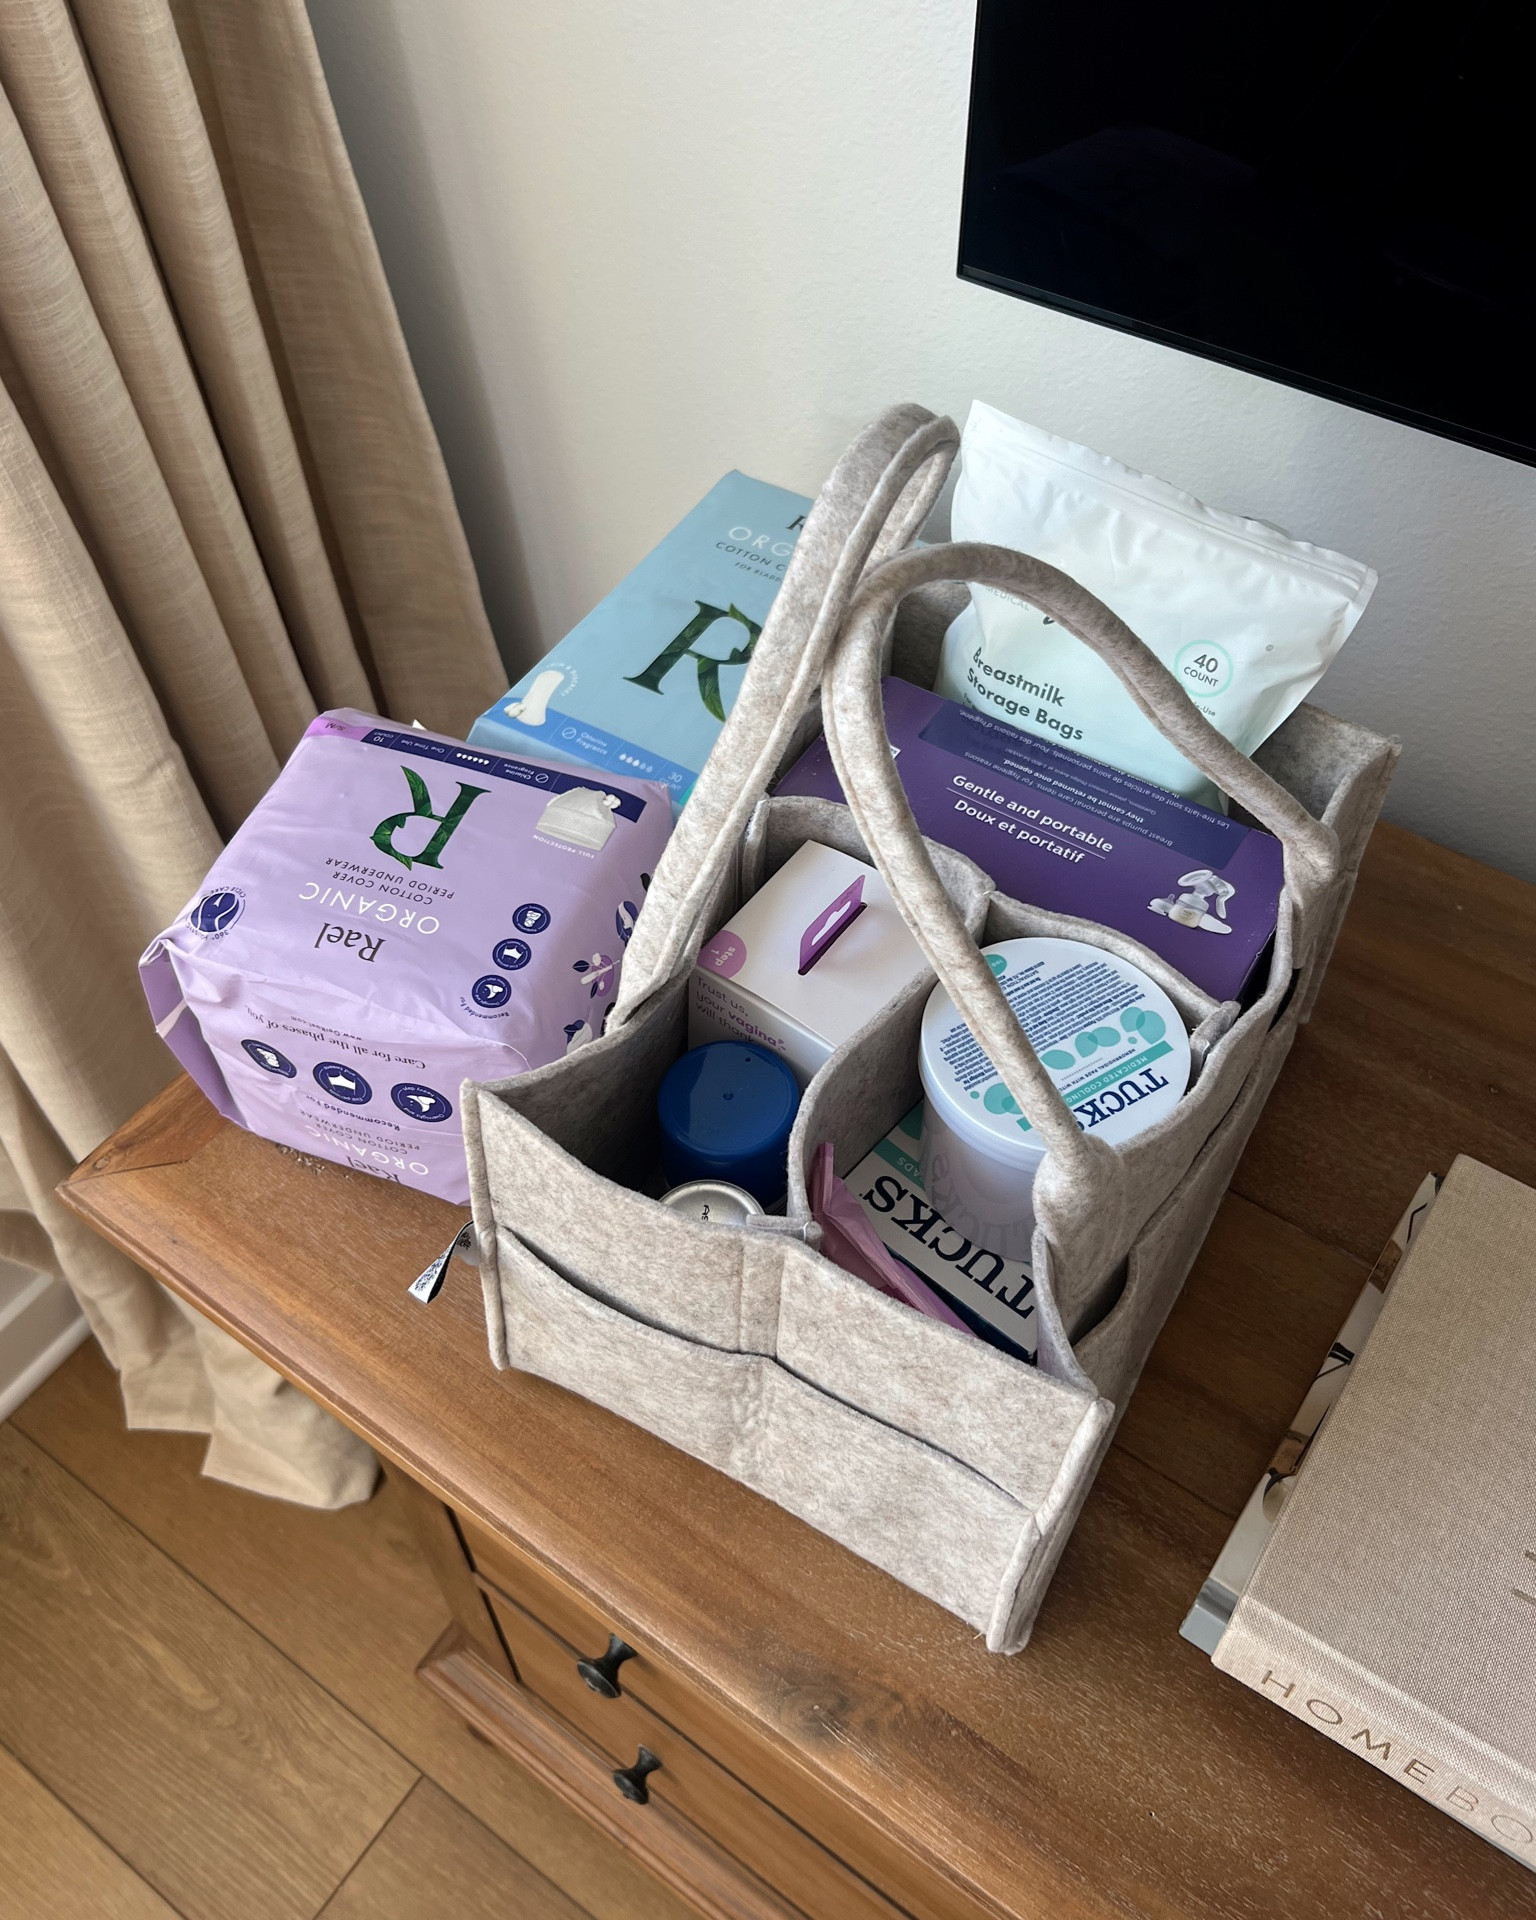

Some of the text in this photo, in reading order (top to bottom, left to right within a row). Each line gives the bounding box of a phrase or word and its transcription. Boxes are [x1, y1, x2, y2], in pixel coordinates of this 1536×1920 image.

[728, 527, 792, 557] ORG
[716, 541, 772, 567] COTTON
[1193, 654, 1219, 673] 40
[973, 646, 1066, 707] Breastmilk
[1183, 666, 1219, 687] COUNT
[967, 667, 1030, 719] Storage
[1036, 712, 1084, 743] Bags
[413, 742, 428, 750] Time
[432, 745, 446, 754] One
[1018, 735, 1032, 745] des
[1031, 742, 1049, 753] Pour
[963, 751, 992, 767] reasons
[505, 769, 532, 780] Chlorine
[668, 771, 683, 783] 30
[991, 763, 1020, 780] hygiene
[1020, 776, 1033, 786] For
[1091, 767, 1111, 779] soins
[1111, 775, 1122, 784] de
[1001, 757, 1144, 823] they cannot be returned once opened.
[1057, 792, 1074, 802] care
[1122, 780, 1150, 796] articles
[1150, 792, 1165, 802] des
[1073, 798, 1107, 818] personal
[1165, 798, 1182, 809] sont
[369, 764, 492, 871] R
[952, 774, 1114, 853] Gentle and portable
[1107, 813, 1121, 823] are
[954, 799, 1085, 864] Doux et portatif
[1121, 819, 1148, 835] pumps
[532, 834, 576, 853] PROTECTION
[1147, 831, 1173, 847] Breast
[325, 857, 456, 900] PERIOD UNDERWEAR
[332, 871, 433, 906] COTTON COVER
[300, 881, 440, 936] ORGANIC
[314, 921, 387, 963] Rael
[715, 946, 736, 967] step
[696, 976, 727, 1003] Trust
[464, 1006, 509, 1018] Recommended
[696, 1002, 716, 1021] will
[696, 991, 777, 1048] your vagina
[266, 1020, 279, 1029] of
[281, 1024, 325, 1042] phases
[327, 1038, 350, 1050] the
[351, 1045, 368, 1055] all
[371, 1050, 391, 1062] for
[393, 1055, 426, 1069] Care
[1057, 1082, 1071, 1092] WITC
[1064, 1054, 1147, 1104] MEDICATED COOLING
[322, 1101, 401, 1131] Recommended
[297, 1109, 420, 1153] PERIOD UNDERWEAR
[314, 1122, 407, 1155] COTTON COVER
[301, 1125, 431, 1176] ORGANIC
[897, 1157, 922, 1185] ADS
[862, 1175, 1035, 1319] TUCKS
